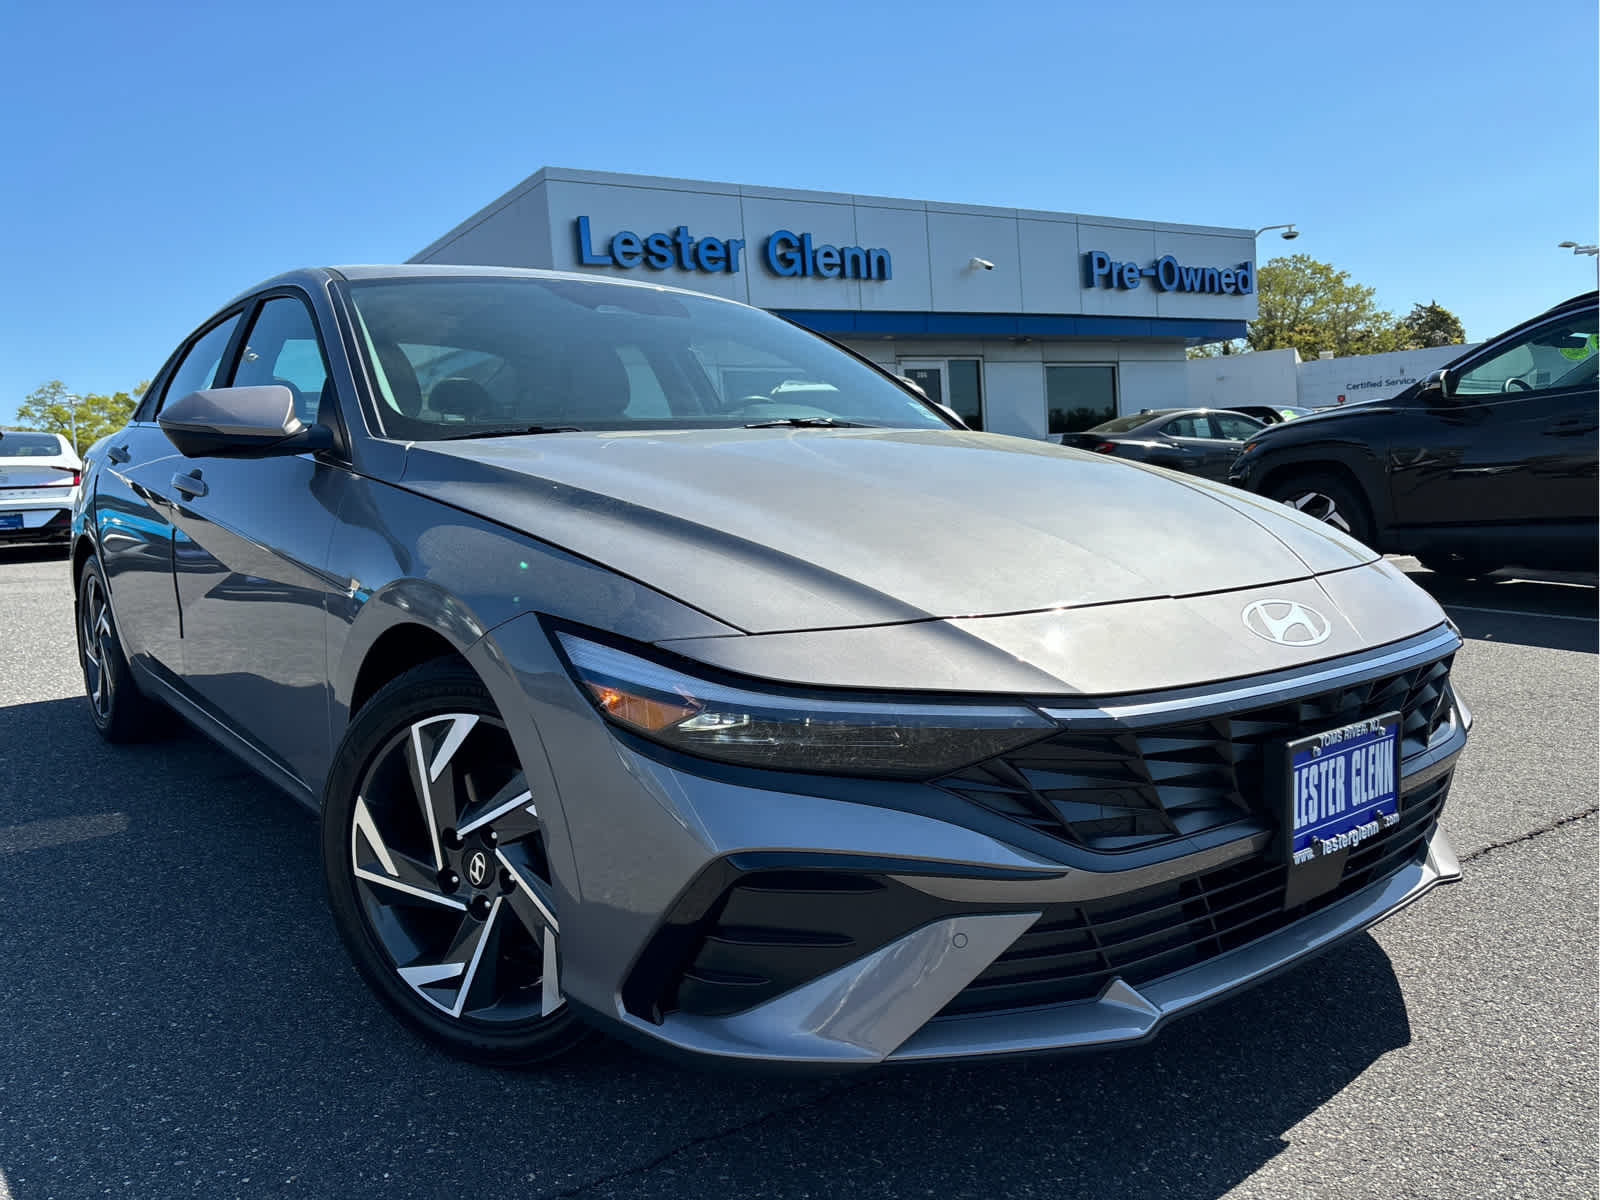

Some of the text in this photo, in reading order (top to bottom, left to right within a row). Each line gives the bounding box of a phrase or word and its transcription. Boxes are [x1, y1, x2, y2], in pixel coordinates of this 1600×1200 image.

[575, 215, 893, 281] Lester Glenn
[1087, 250, 1254, 295] Pre-Owned
[1345, 377, 1417, 390] Certified Service
[1320, 730, 1343, 747] TOMS
[1293, 738, 1394, 831] LESTER GLENN
